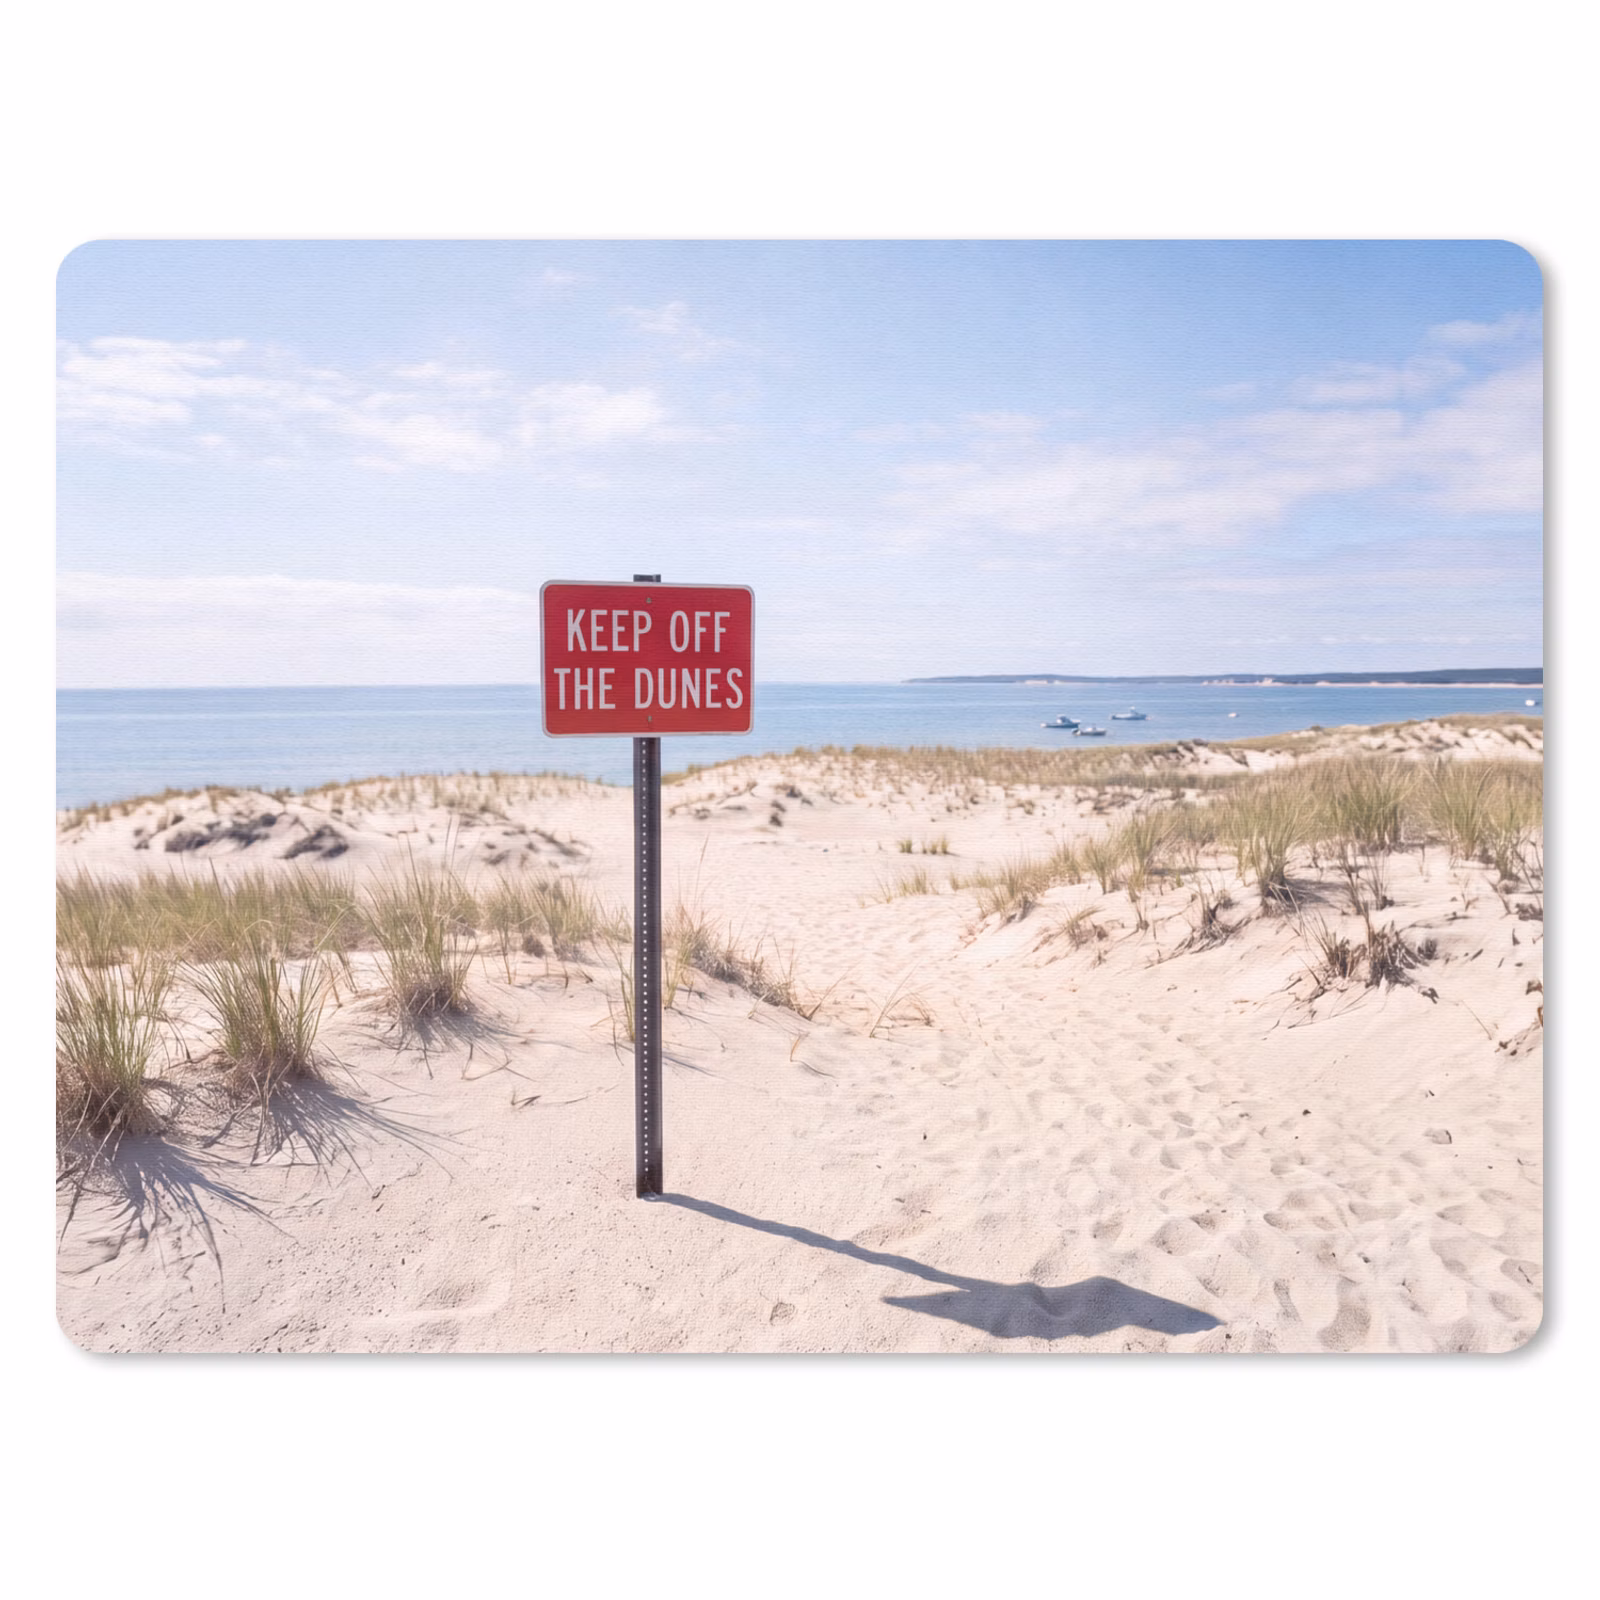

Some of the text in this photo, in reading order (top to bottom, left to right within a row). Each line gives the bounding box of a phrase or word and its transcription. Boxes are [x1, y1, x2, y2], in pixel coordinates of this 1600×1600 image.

[567, 609, 731, 653] KEEP OFF
[553, 667, 744, 710] THE DUNES
